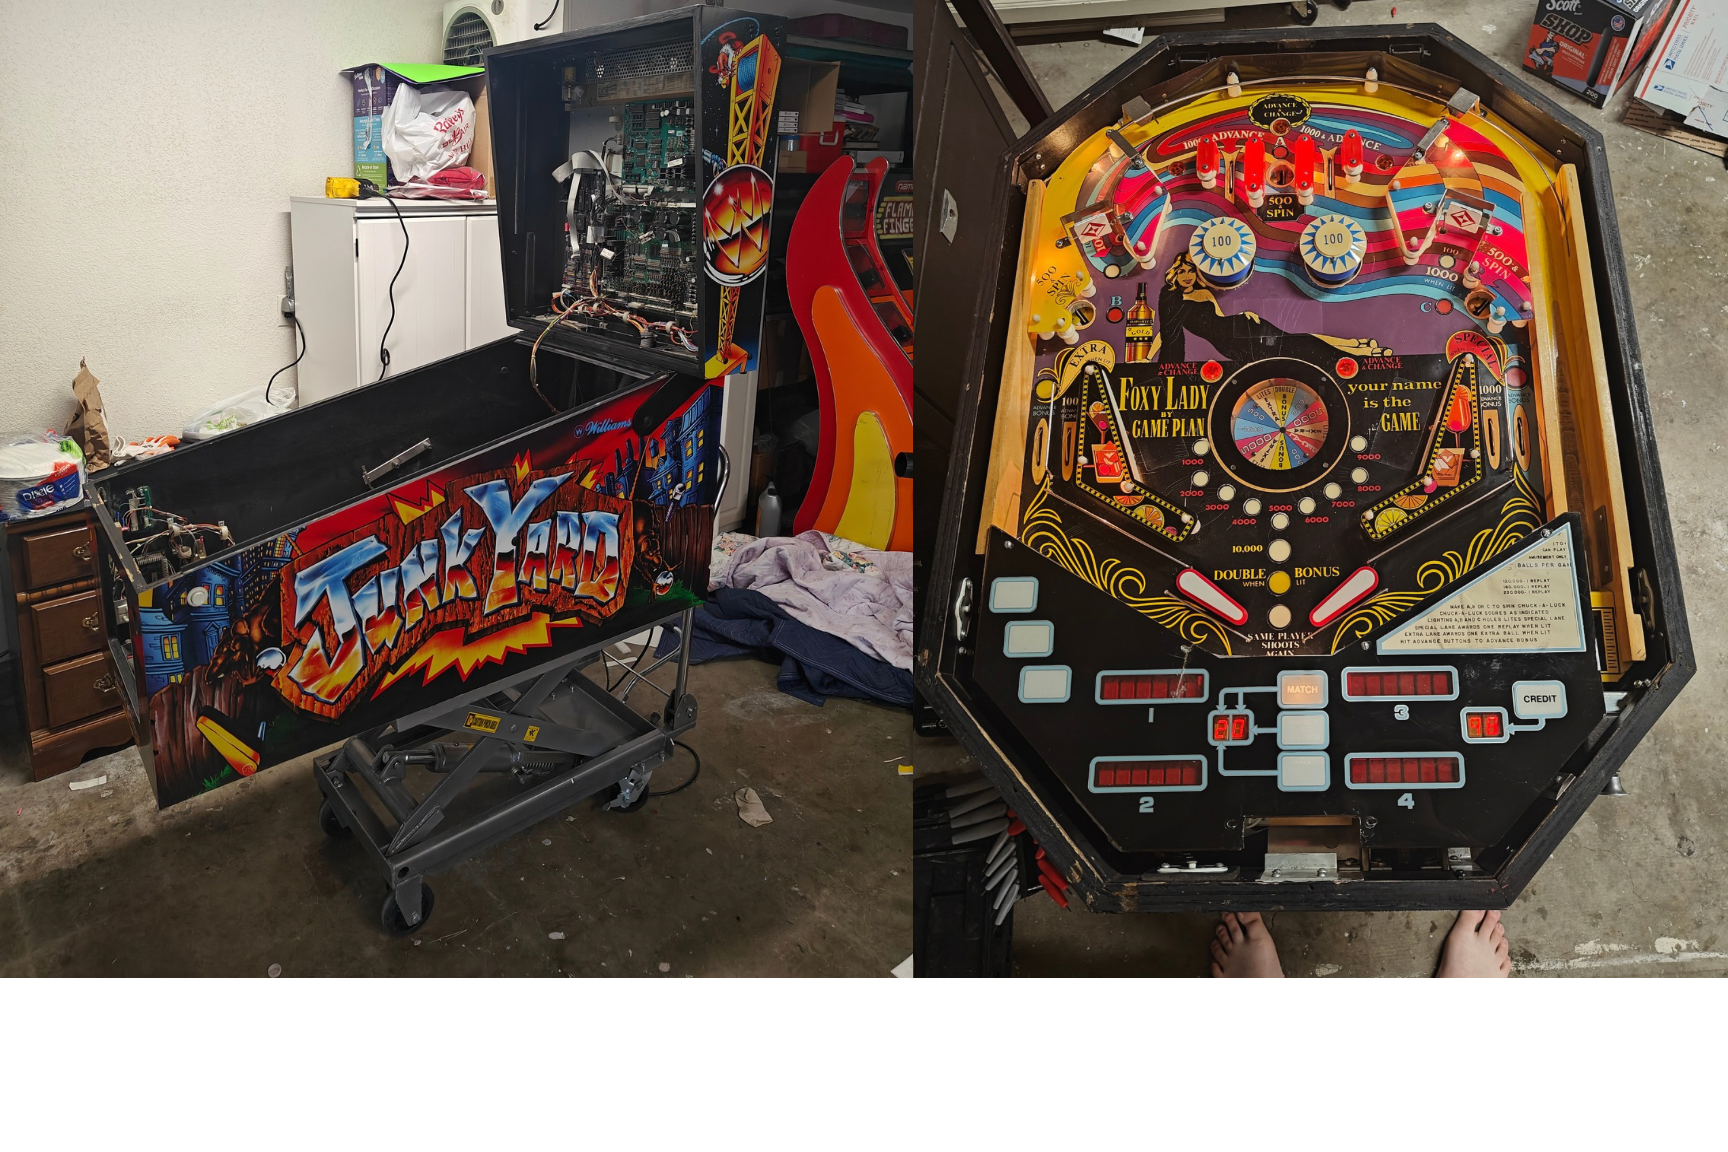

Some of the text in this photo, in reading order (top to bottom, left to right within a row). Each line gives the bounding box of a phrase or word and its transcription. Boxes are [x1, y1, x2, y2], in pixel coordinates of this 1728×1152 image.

[1682, 5, 1696, 29] PRIORITY
[1540, 12, 1593, 45] SHOP
[1559, 41, 1586, 59] ORIGINAL
[1586, 89, 1599, 99] 200
[1264, 109, 1298, 118] CHANGE
[1300, 125, 1321, 138] 1000
[1275, 137, 1286, 146] A
[1268, 196, 1293, 206] 500
[1266, 209, 1295, 218] SPIN
[1212, 236, 1232, 248] 100
[1323, 233, 1343, 245] 100
[1443, 246, 1460, 256] 100
[1487, 247, 1519, 273] 500 &
[1426, 266, 1459, 283] 1000
[1481, 257, 1512, 280] SPIN
[1036, 266, 1058, 287] 500
[1047, 273, 1071, 297] SPIN
[1424, 278, 1456, 292] WHEN LIT
[1112, 296, 1123, 306] B
[1420, 301, 1432, 313] C
[1069, 343, 1107, 368] EXTRA
[1454, 333, 1497, 368] SPECIAL
[1362, 356, 1401, 364] ADVANCE
[1119, 376, 1210, 411] FOXY LADY
[1256, 389, 1271, 399] LITES
[1274, 386, 1295, 394] DOUBLE
[1347, 381, 1442, 395] your name
[1480, 384, 1502, 394] 1000
[1363, 397, 1412, 409] is the
[1248, 408, 1265, 421] 500
[1264, 398, 1279, 422] EXTRA
[585, 418, 633, 436] Williams
[1132, 418, 1205, 438] GAME PLAN
[1381, 411, 1420, 432] GAME
[1241, 434, 1272, 454] 5000
[1260, 438, 1278, 462] EXTRA
[1182, 458, 1204, 466] 1000
[1357, 453, 1381, 461] 9000
[1205, 503, 1229, 511] 3000
[1269, 504, 1293, 512] 5000
[1232, 518, 1257, 526] 4000
[1305, 516, 1329, 524] 6000
[1214, 567, 1340, 581] DOUBLE BONUS
[287, 471, 621, 704] JUNK YARD
[1242, 580, 1265, 588] WHEN
[1247, 632, 1314, 641] SAME PLAYER
[1261, 641, 1300, 649] SHOOTS
[1286, 685, 1319, 694] MATCH
[1523, 695, 1557, 703] CREDIT
[1148, 707, 1154, 723] 1
[1394, 704, 1409, 721] 3
[1214, 718, 1246, 739] 20
[1470, 716, 1500, 735] 98
[1139, 796, 1154, 813] 2
[1397, 792, 1415, 810] 4
